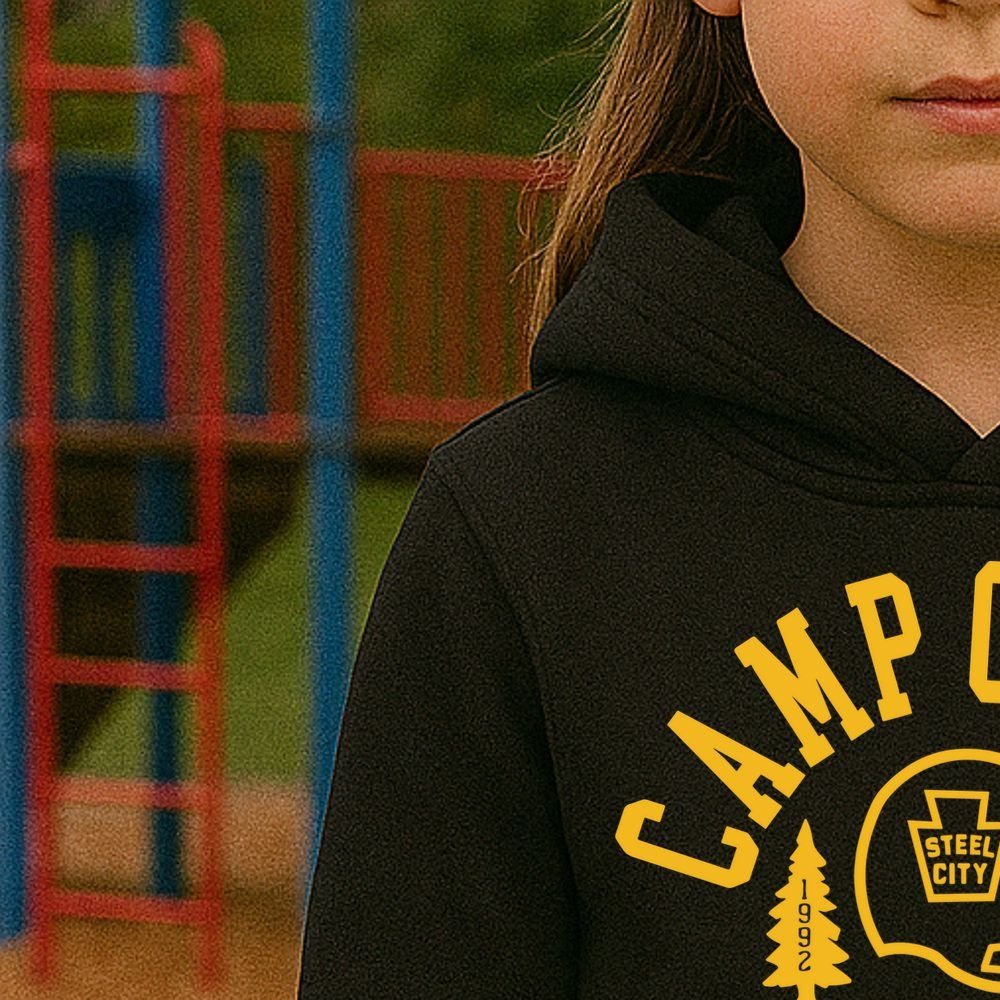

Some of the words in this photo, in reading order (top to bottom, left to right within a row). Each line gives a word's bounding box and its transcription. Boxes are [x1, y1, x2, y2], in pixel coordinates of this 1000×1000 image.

[614, 572, 922, 889] CAMP
[924, 833, 995, 859] STEEL
[932, 862, 988, 885] CITY
[797, 878, 812, 972] 1992
